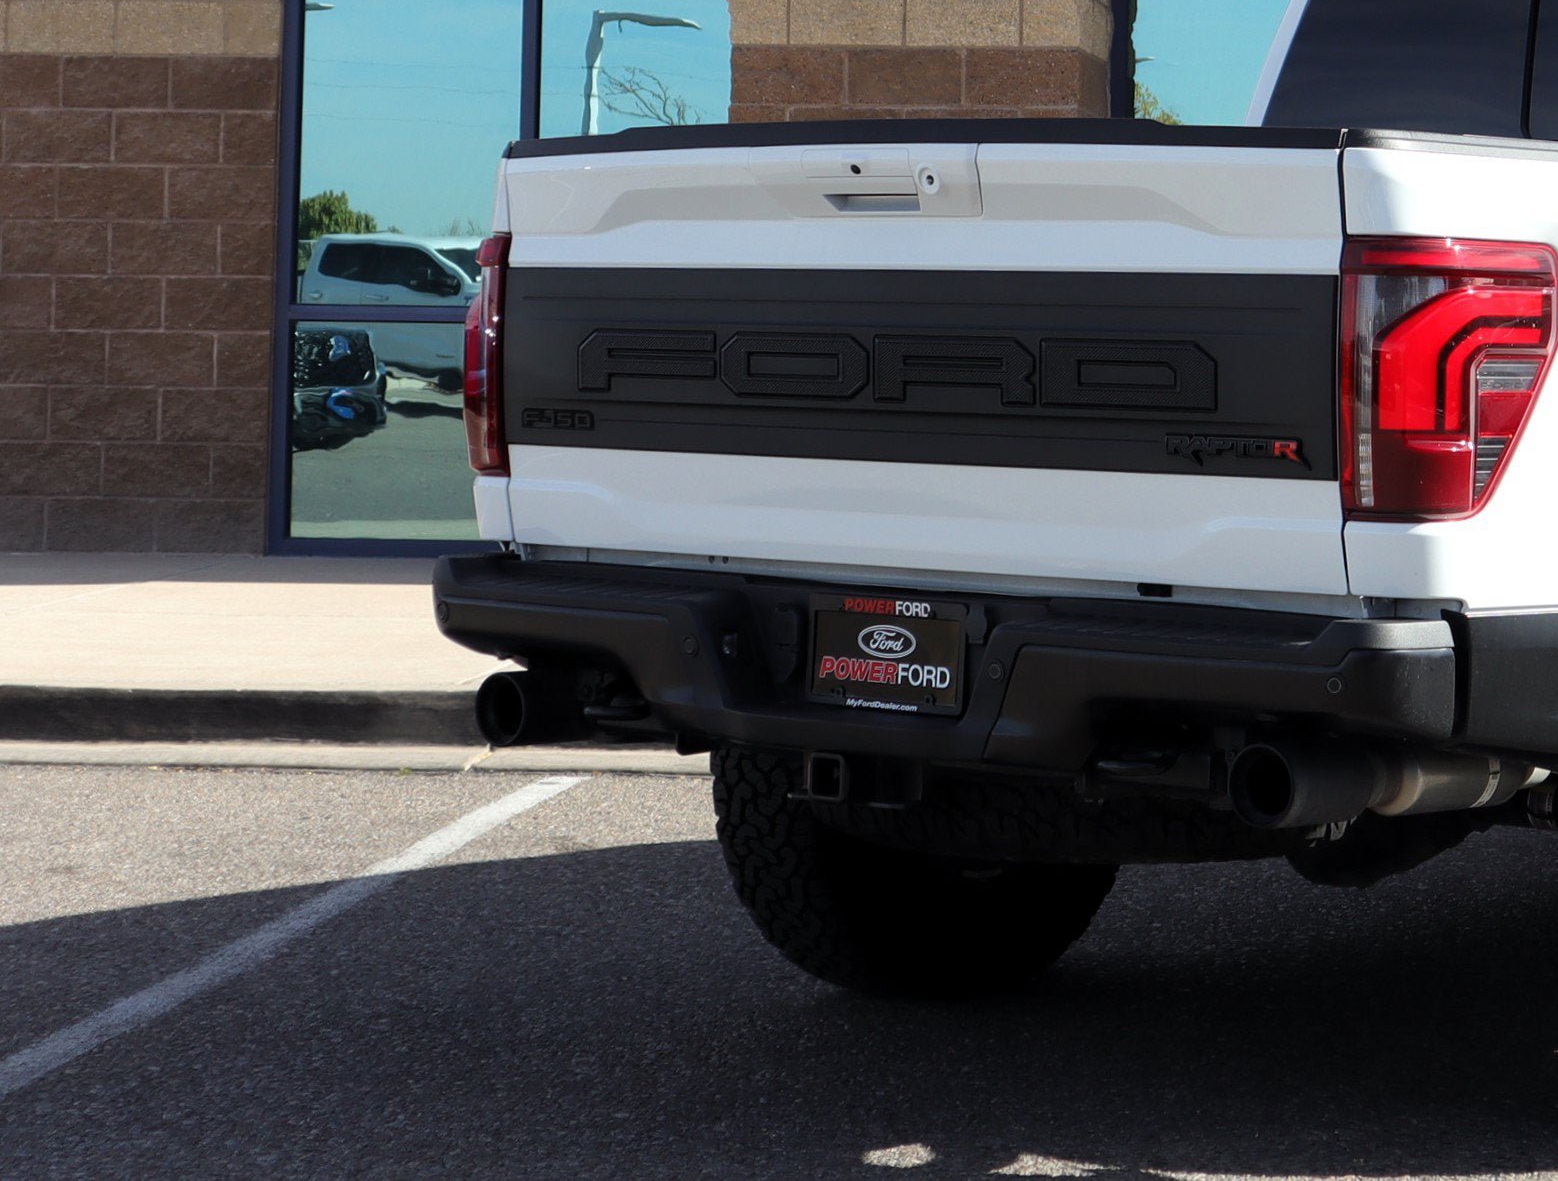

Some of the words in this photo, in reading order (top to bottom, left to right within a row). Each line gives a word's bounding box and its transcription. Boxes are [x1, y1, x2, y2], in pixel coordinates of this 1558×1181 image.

[578, 329, 1217, 411] FORD
[1164, 433, 1314, 471] RAPTOR
[869, 630, 904, 652] Ford
[846, 697, 918, 712] MyFordDealer.com
